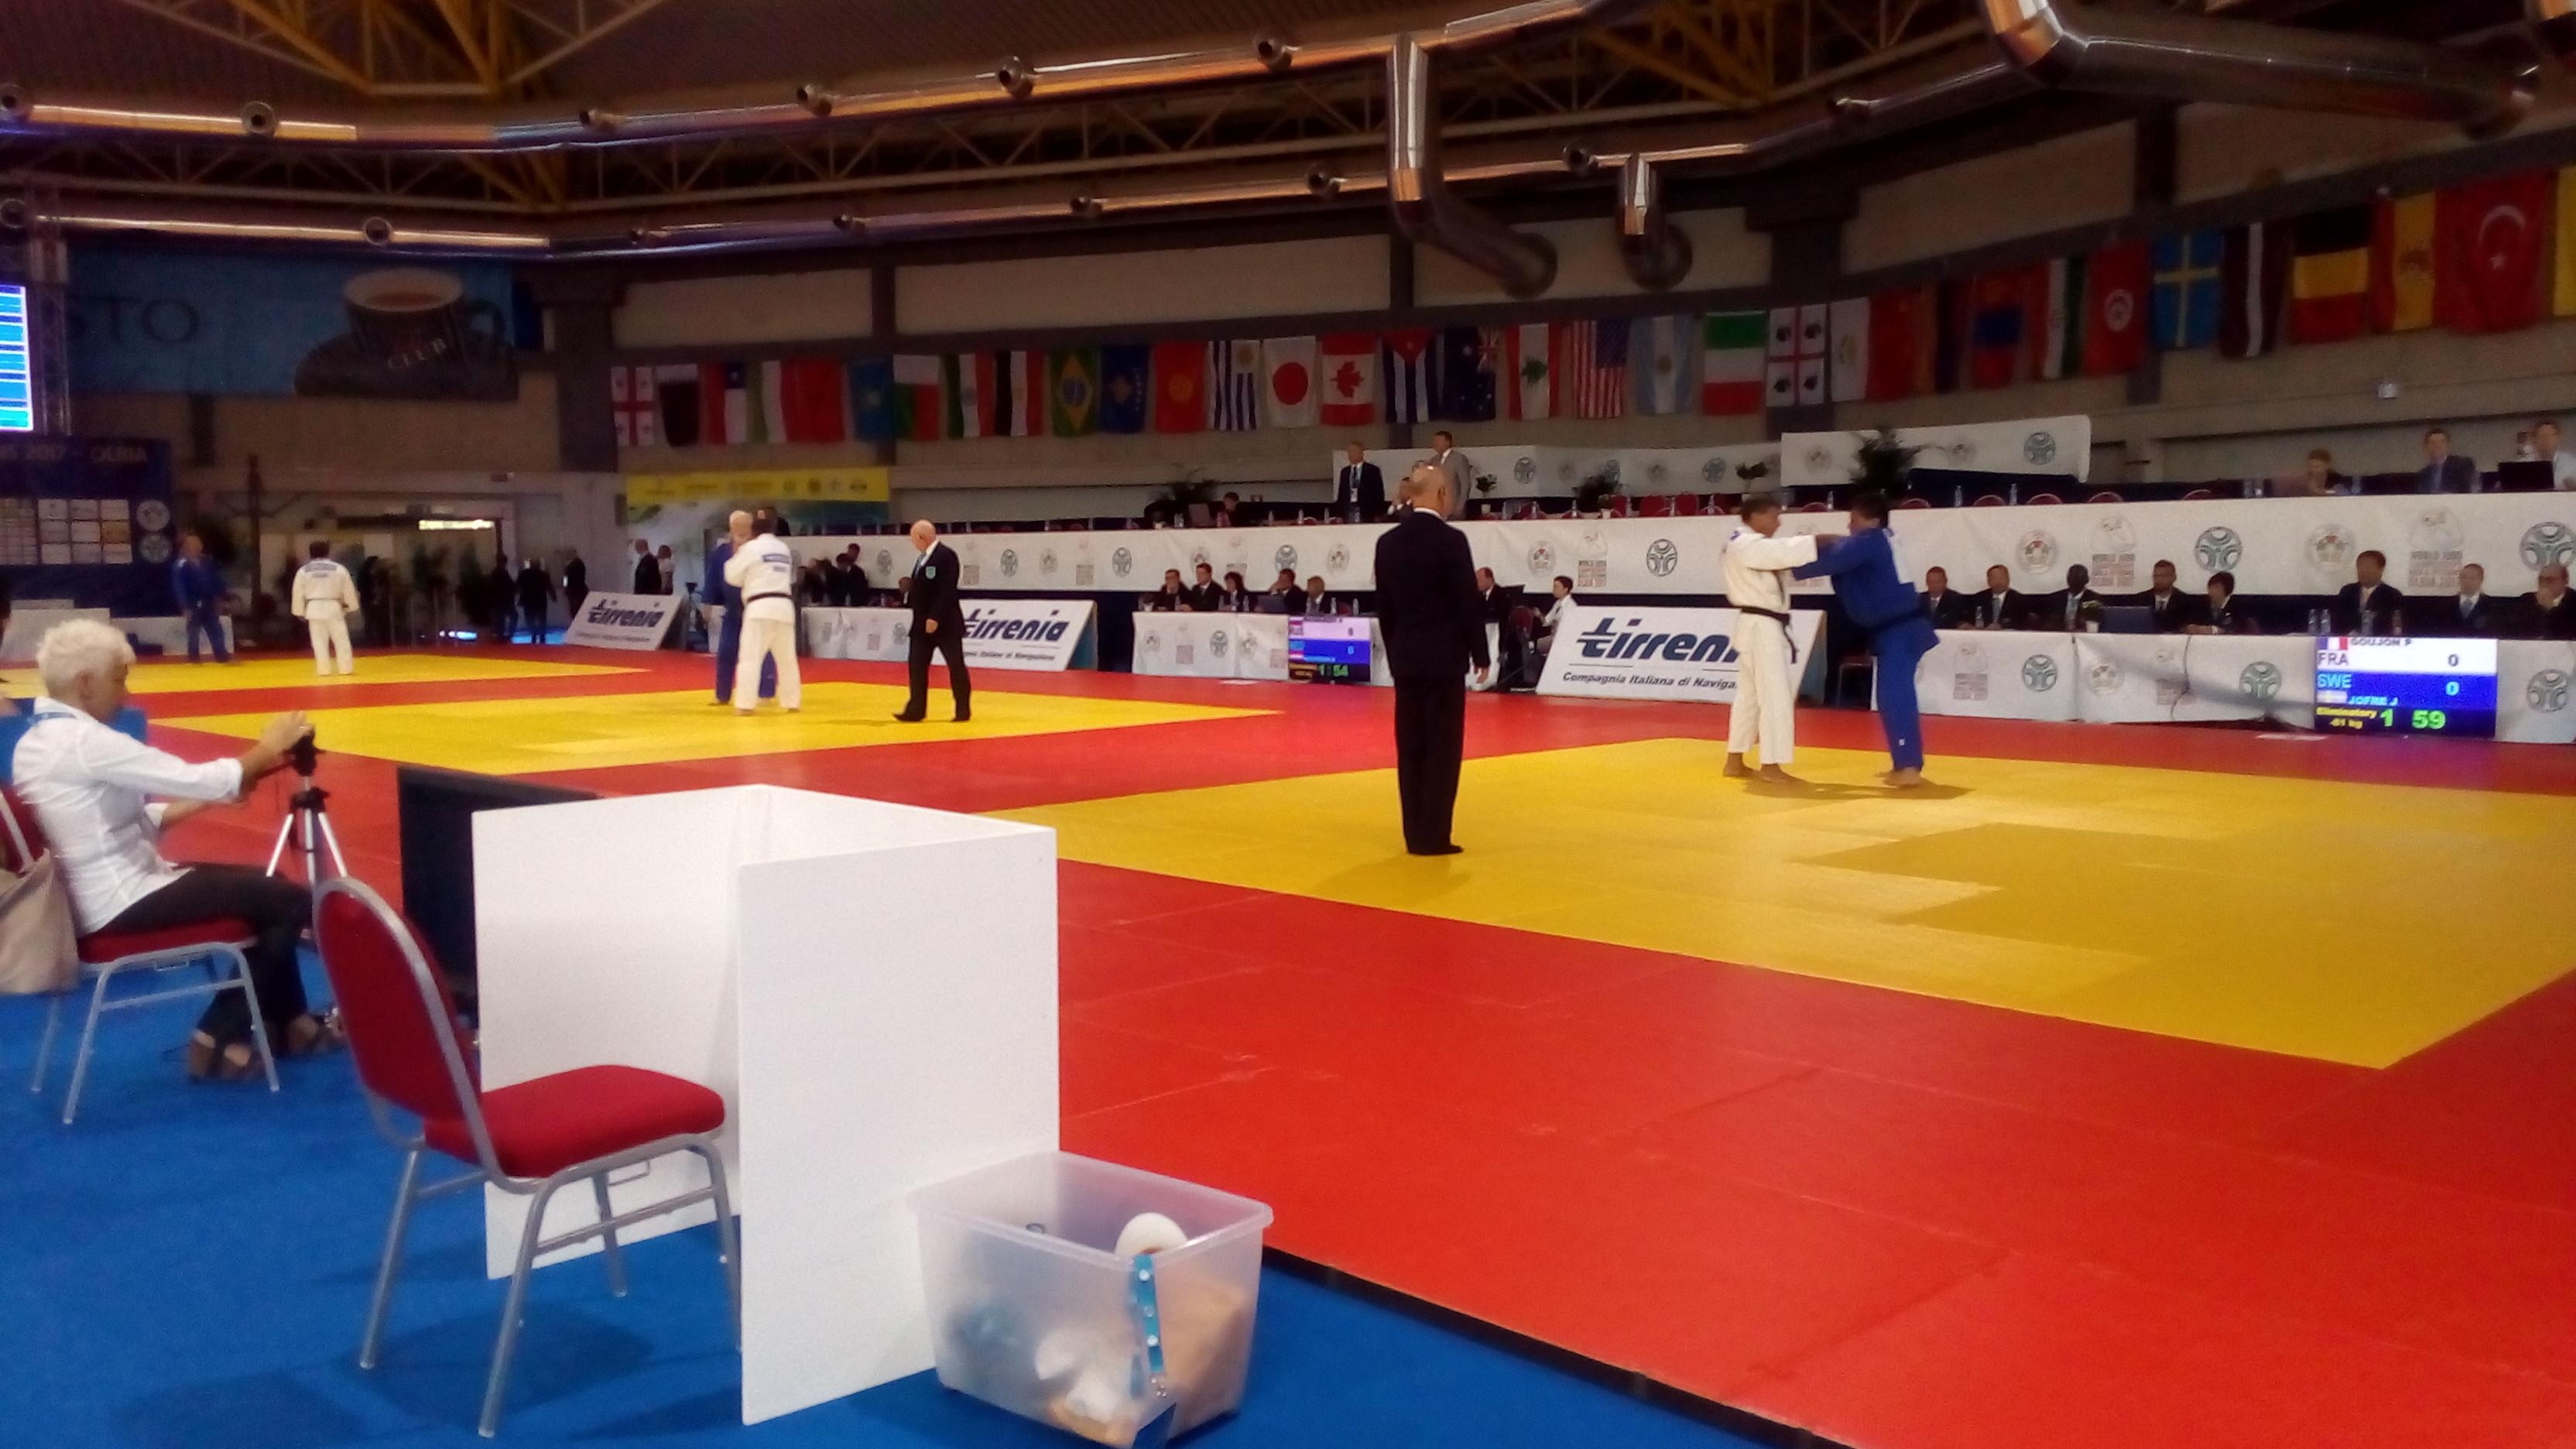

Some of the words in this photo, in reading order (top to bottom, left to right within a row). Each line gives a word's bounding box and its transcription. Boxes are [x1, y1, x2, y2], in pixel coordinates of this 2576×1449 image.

[2317, 652, 2349, 666] FRA
[2448, 654, 2460, 666] 0
[1562, 672, 1626, 685] Compagnia
[1629, 673, 1675, 686] Italiana
[1678, 676, 1690, 686] di
[1693, 677, 1738, 690] Naviga
[2317, 674, 2352, 688] SWE
[2445, 682, 2460, 696] 0
[2380, 709, 2393, 727] 1
[2412, 711, 2447, 729] 59
